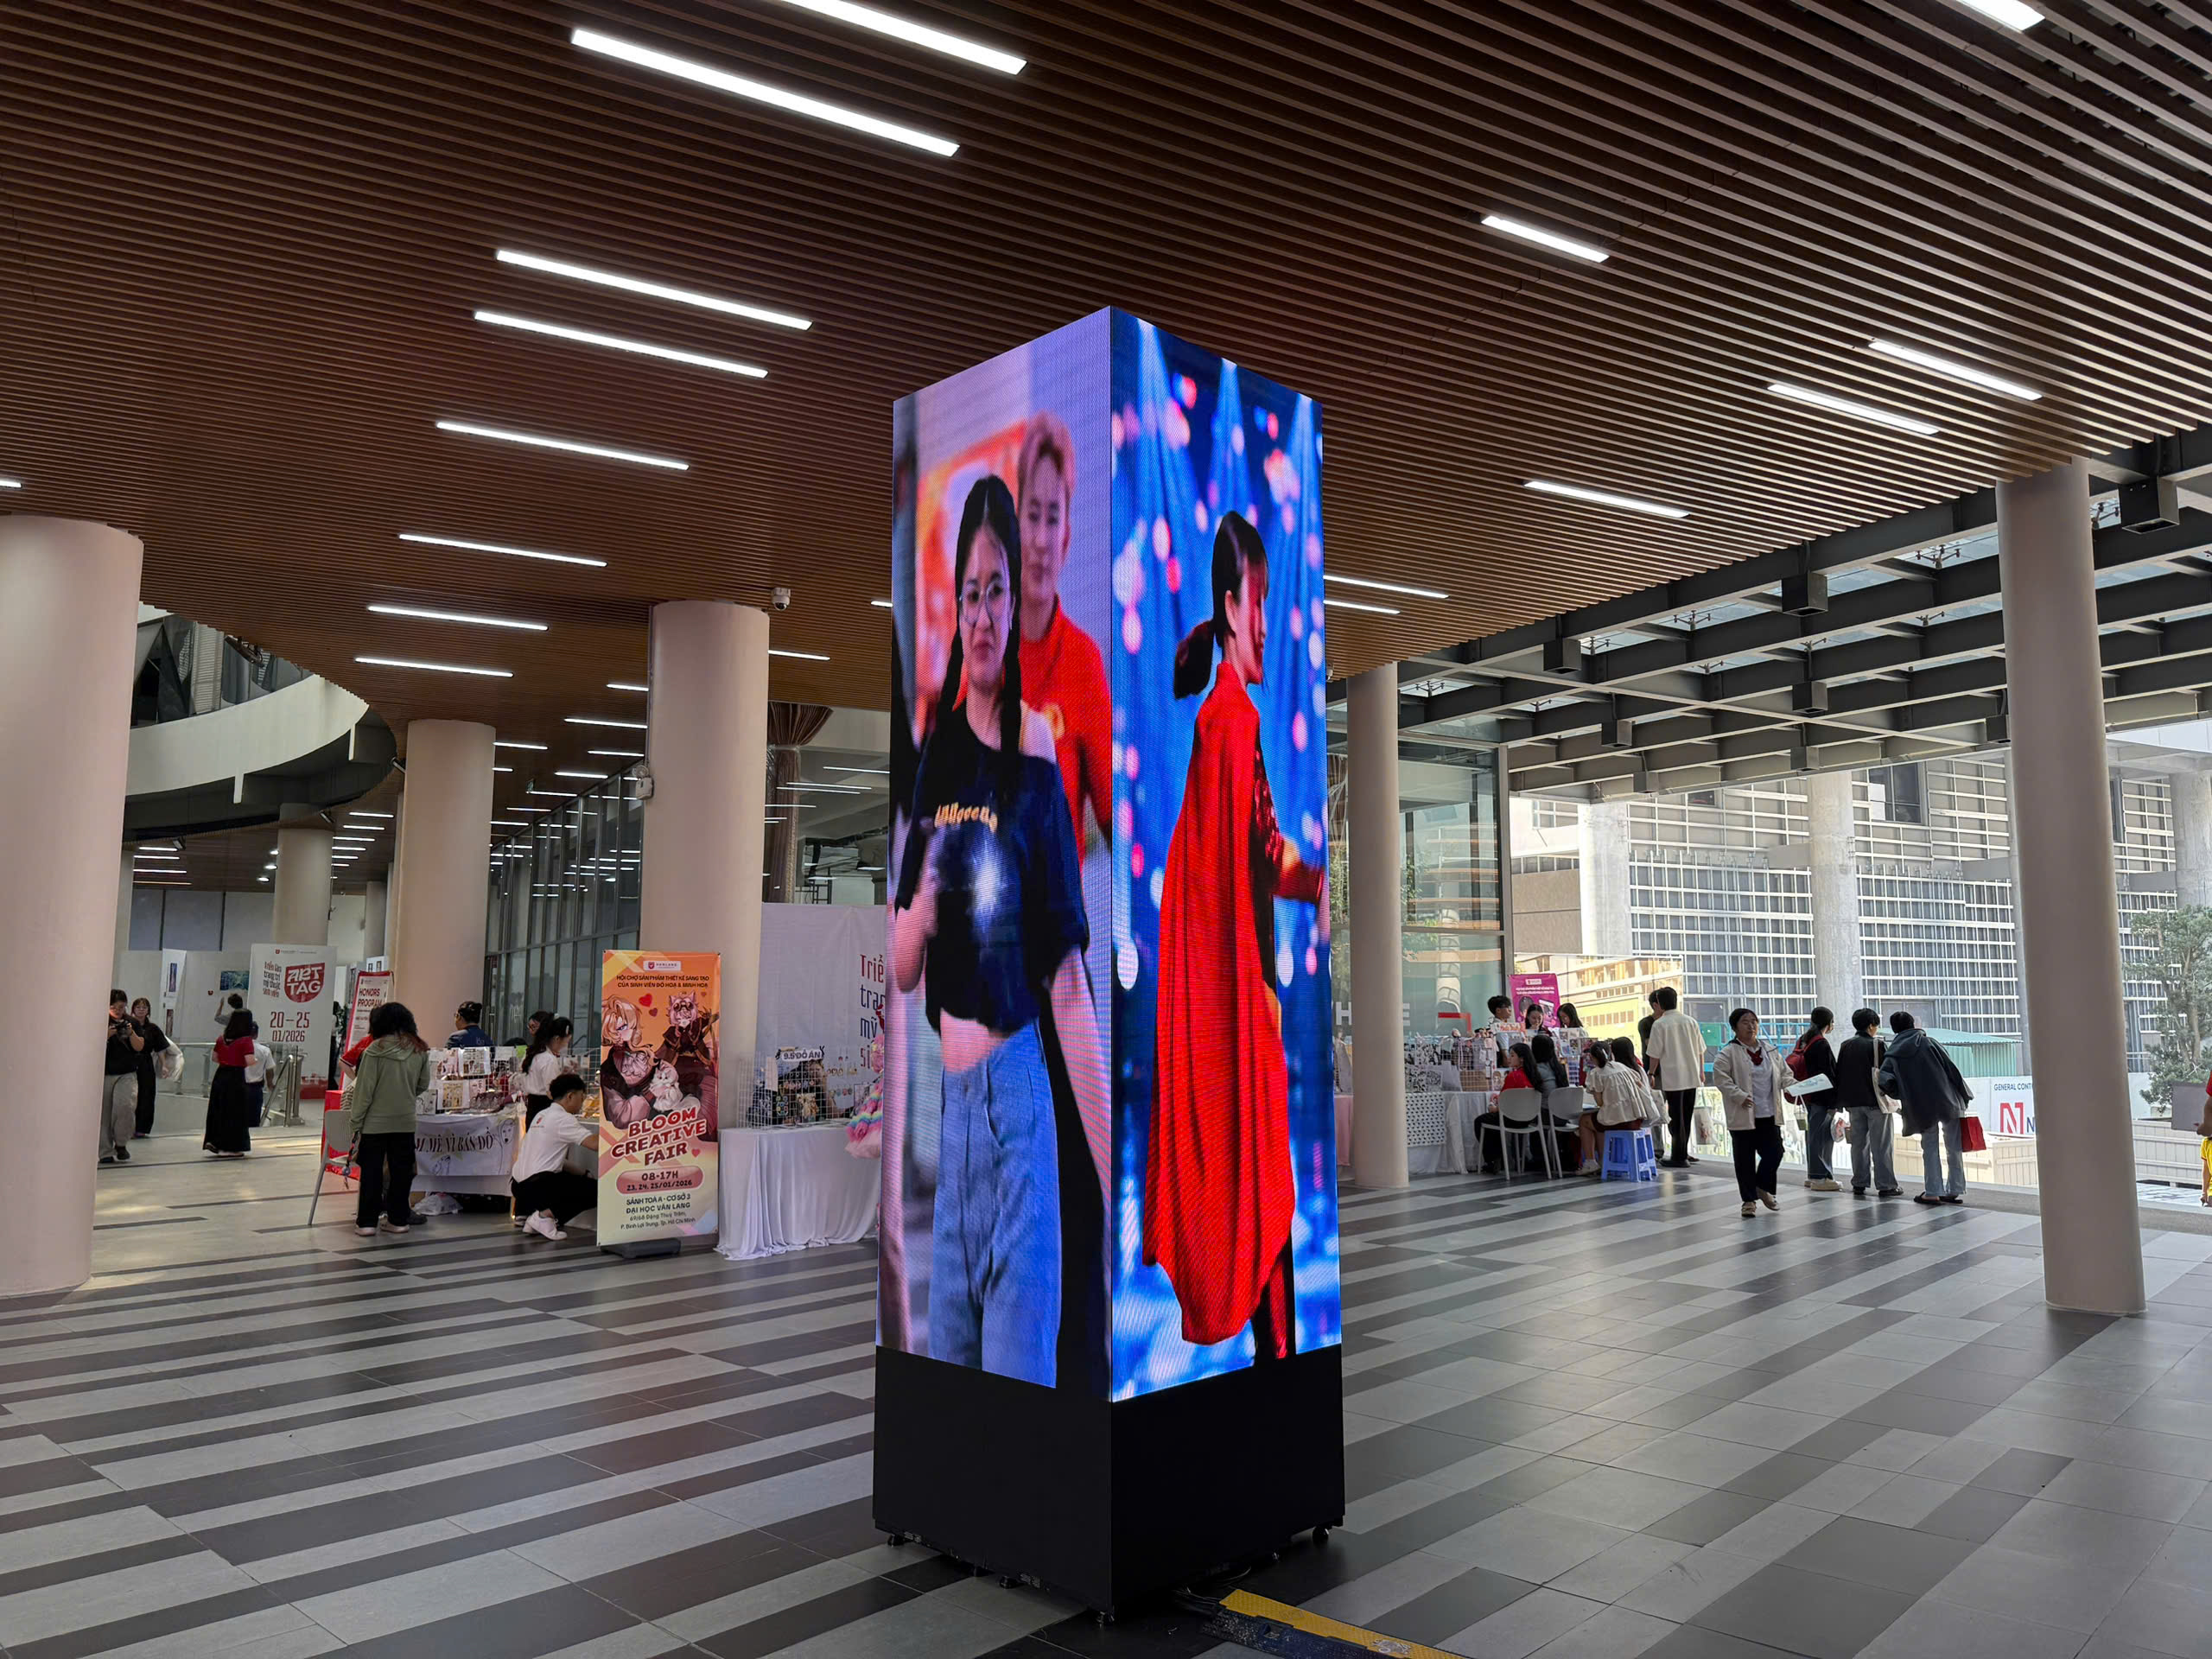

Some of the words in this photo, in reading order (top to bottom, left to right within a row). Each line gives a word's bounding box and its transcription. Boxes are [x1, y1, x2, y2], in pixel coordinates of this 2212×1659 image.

[288, 967, 321, 982] ART
[859, 954, 885, 983] Triể
[287, 981, 321, 995] TAG
[359, 988, 380, 997] HONORS
[272, 1030, 305, 1042] 01/2026
[629, 1107, 696, 1137] BLOOM
[2027, 1116, 2035, 1133] N
[612, 1120, 707, 1158] CREATIVE
[645, 1142, 687, 1166] FAIR
[641, 1170, 678, 1181] 08-17H
[651, 1179, 693, 1189] 25/01/2026
